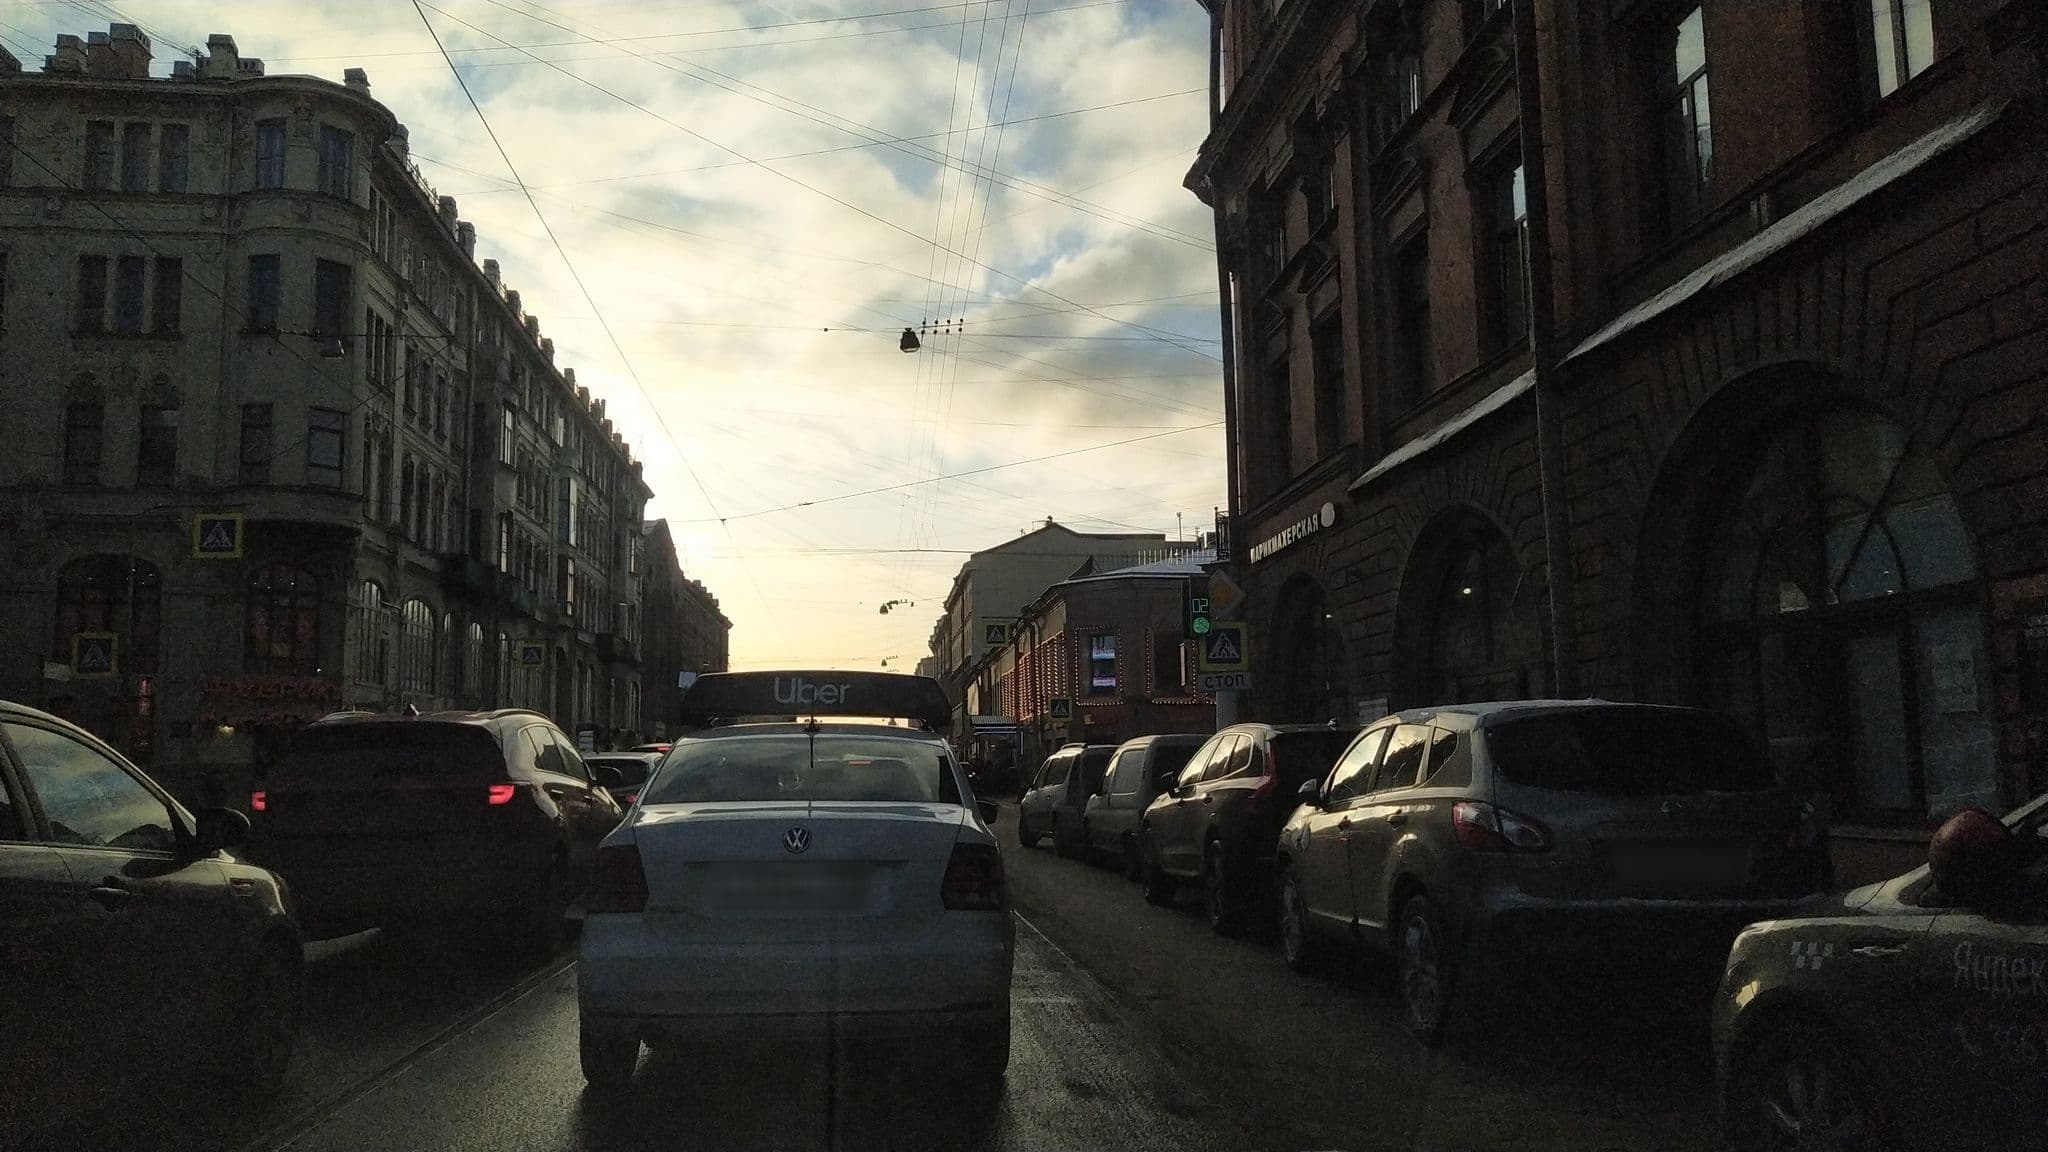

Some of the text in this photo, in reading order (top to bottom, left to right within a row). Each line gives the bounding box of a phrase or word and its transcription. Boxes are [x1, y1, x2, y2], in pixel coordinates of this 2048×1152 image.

[1250, 513, 1319, 565] ПАРИКМАХЕРСКАЯ
[1192, 598, 1209, 613] 02
[774, 676, 850, 704] Uber
[1205, 674, 1244, 689] СТОП
